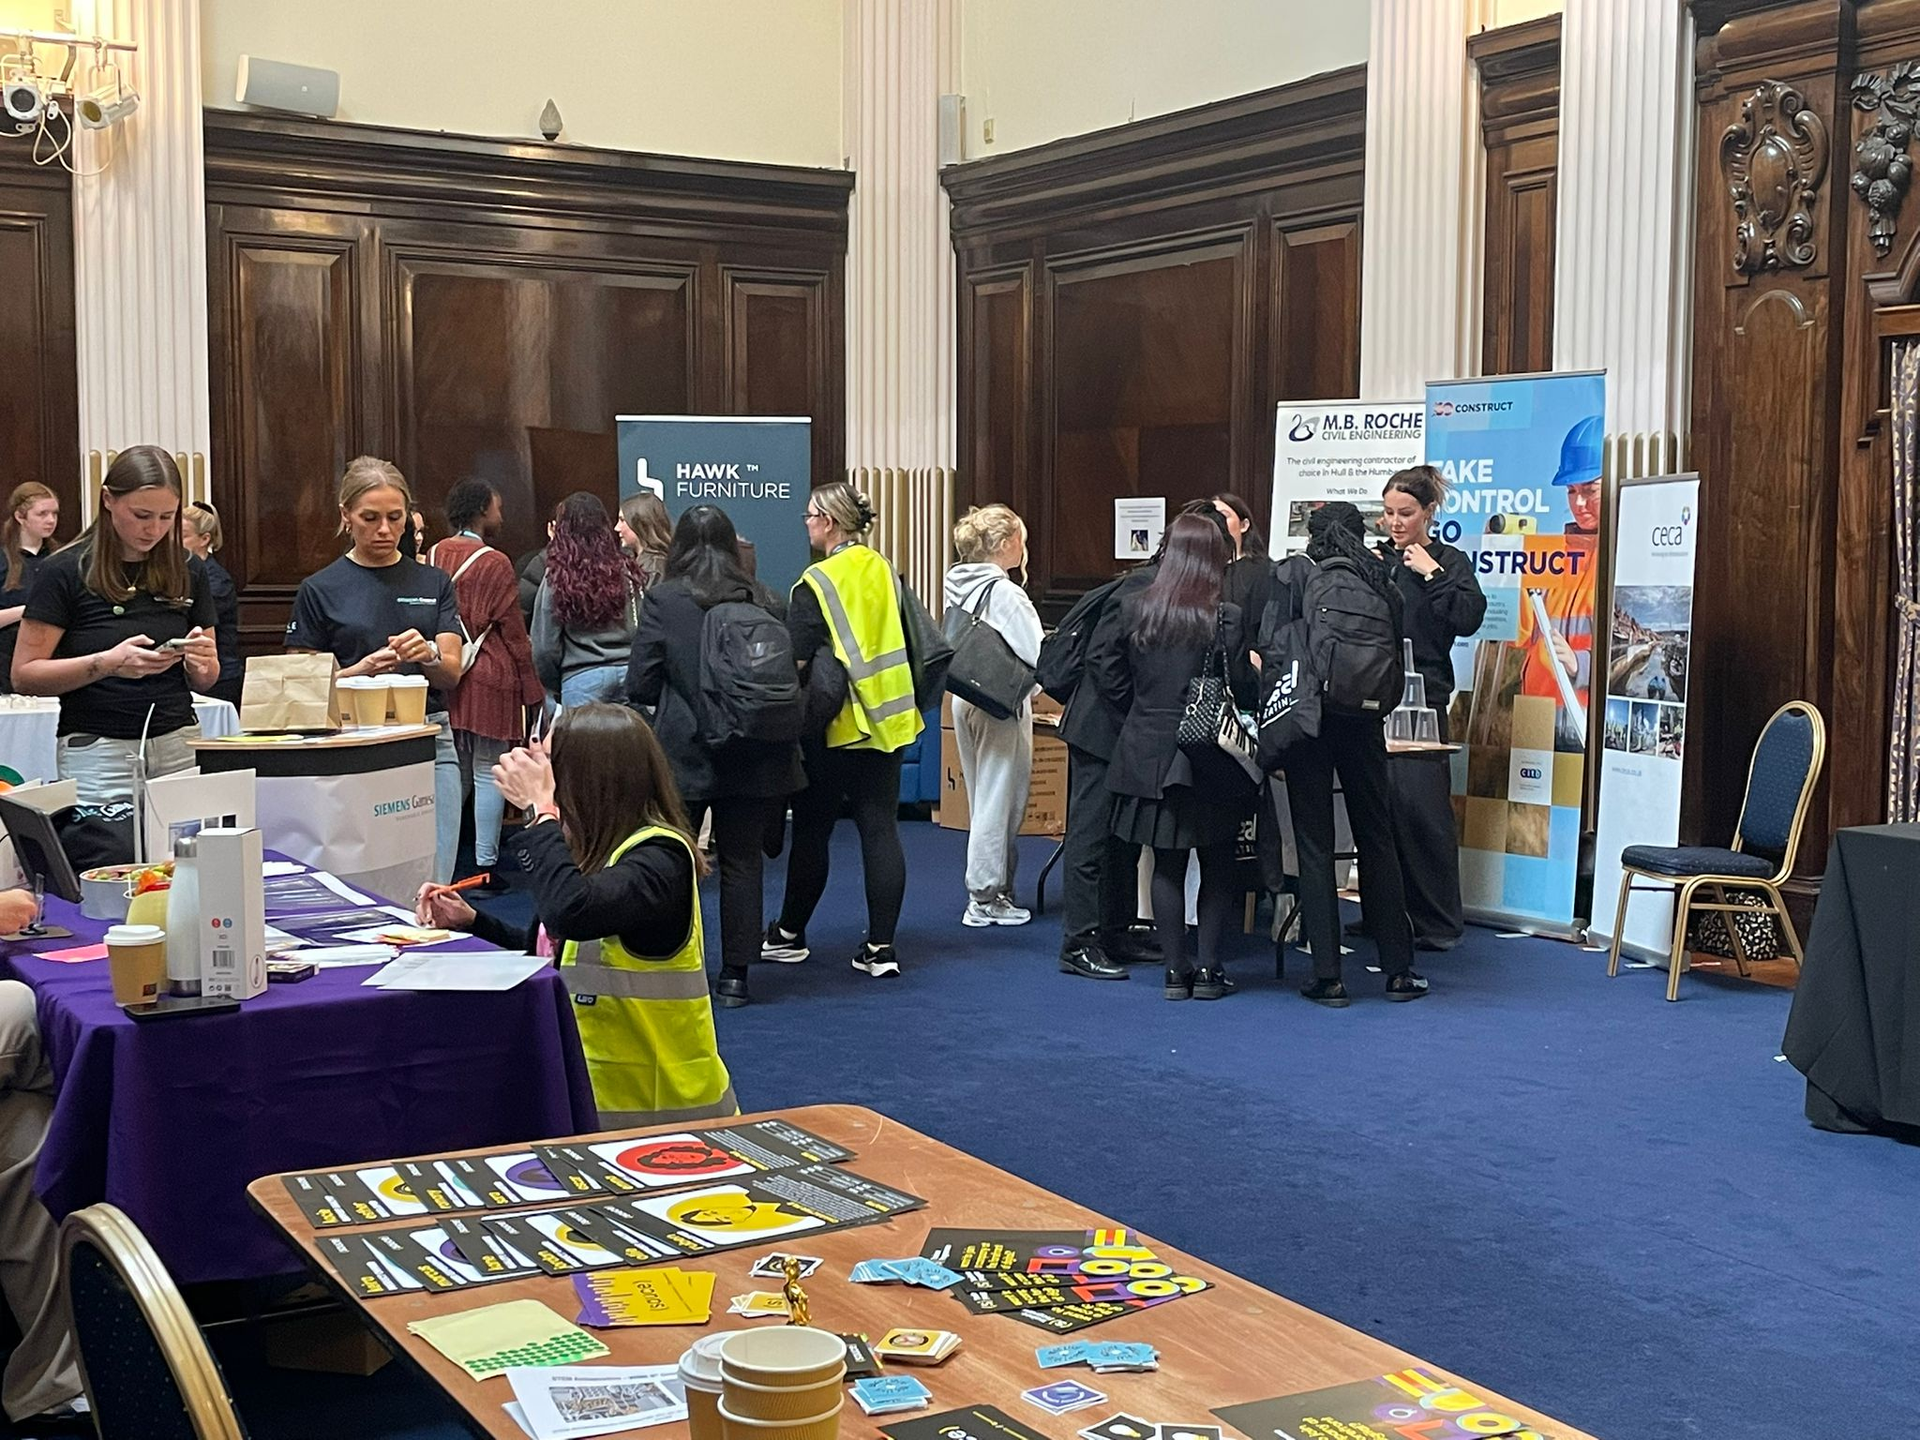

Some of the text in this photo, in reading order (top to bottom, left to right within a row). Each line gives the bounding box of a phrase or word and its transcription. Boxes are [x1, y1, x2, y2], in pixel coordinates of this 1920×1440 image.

[1455, 401, 1513, 413] CONSTRUCT
[1323, 413, 1423, 430] M.B. ROCHE
[1322, 429, 1421, 441] CIVIL ENGINEERING
[1302, 457, 1316, 465] civil
[1317, 457, 1363, 468] engineering
[1364, 457, 1406, 465] contractor
[1407, 455, 1416, 464] of
[676, 463, 759, 480] HAWK TM
[1298, 469, 1320, 477] choice
[1331, 468, 1347, 476] Hull
[1356, 468, 1367, 476] the
[677, 481, 791, 499] FURNITURE
[1437, 488, 1550, 514] ONTROL
[1652, 525, 1683, 547] ceca
[374, 799, 411, 817] SIEMENS
